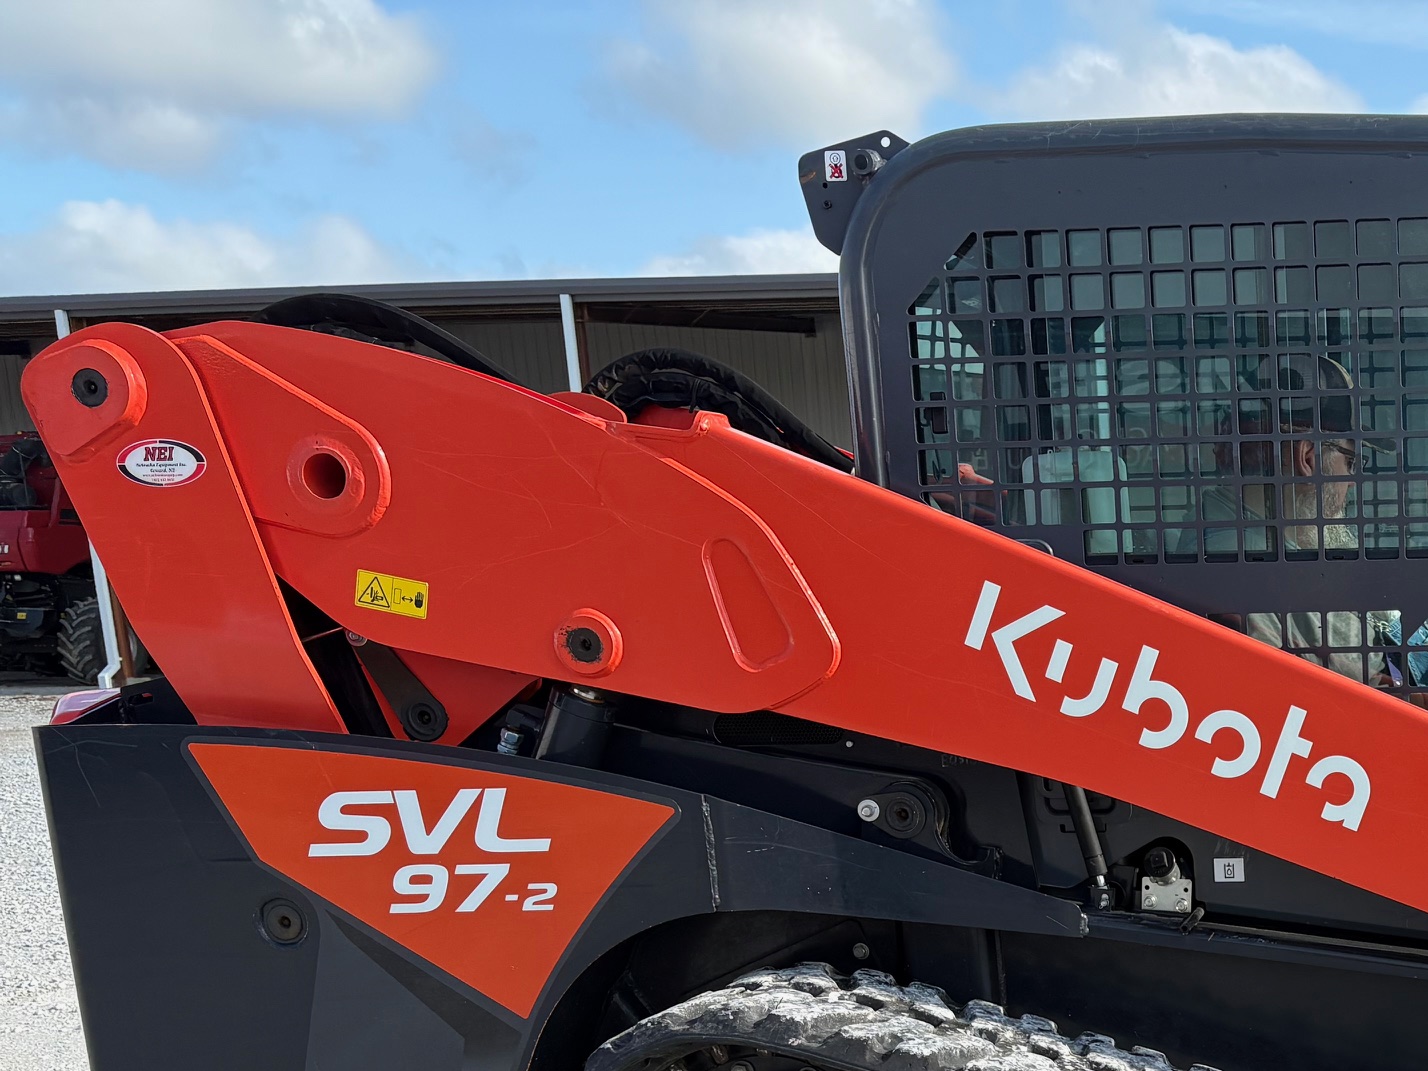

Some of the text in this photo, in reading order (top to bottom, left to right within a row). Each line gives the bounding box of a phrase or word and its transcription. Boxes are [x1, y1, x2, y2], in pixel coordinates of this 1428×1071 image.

[143, 446, 175, 462] NEI
[963, 579, 1371, 832] Kubota
[308, 787, 551, 857] SVL
[389, 863, 558, 914] 97-2
